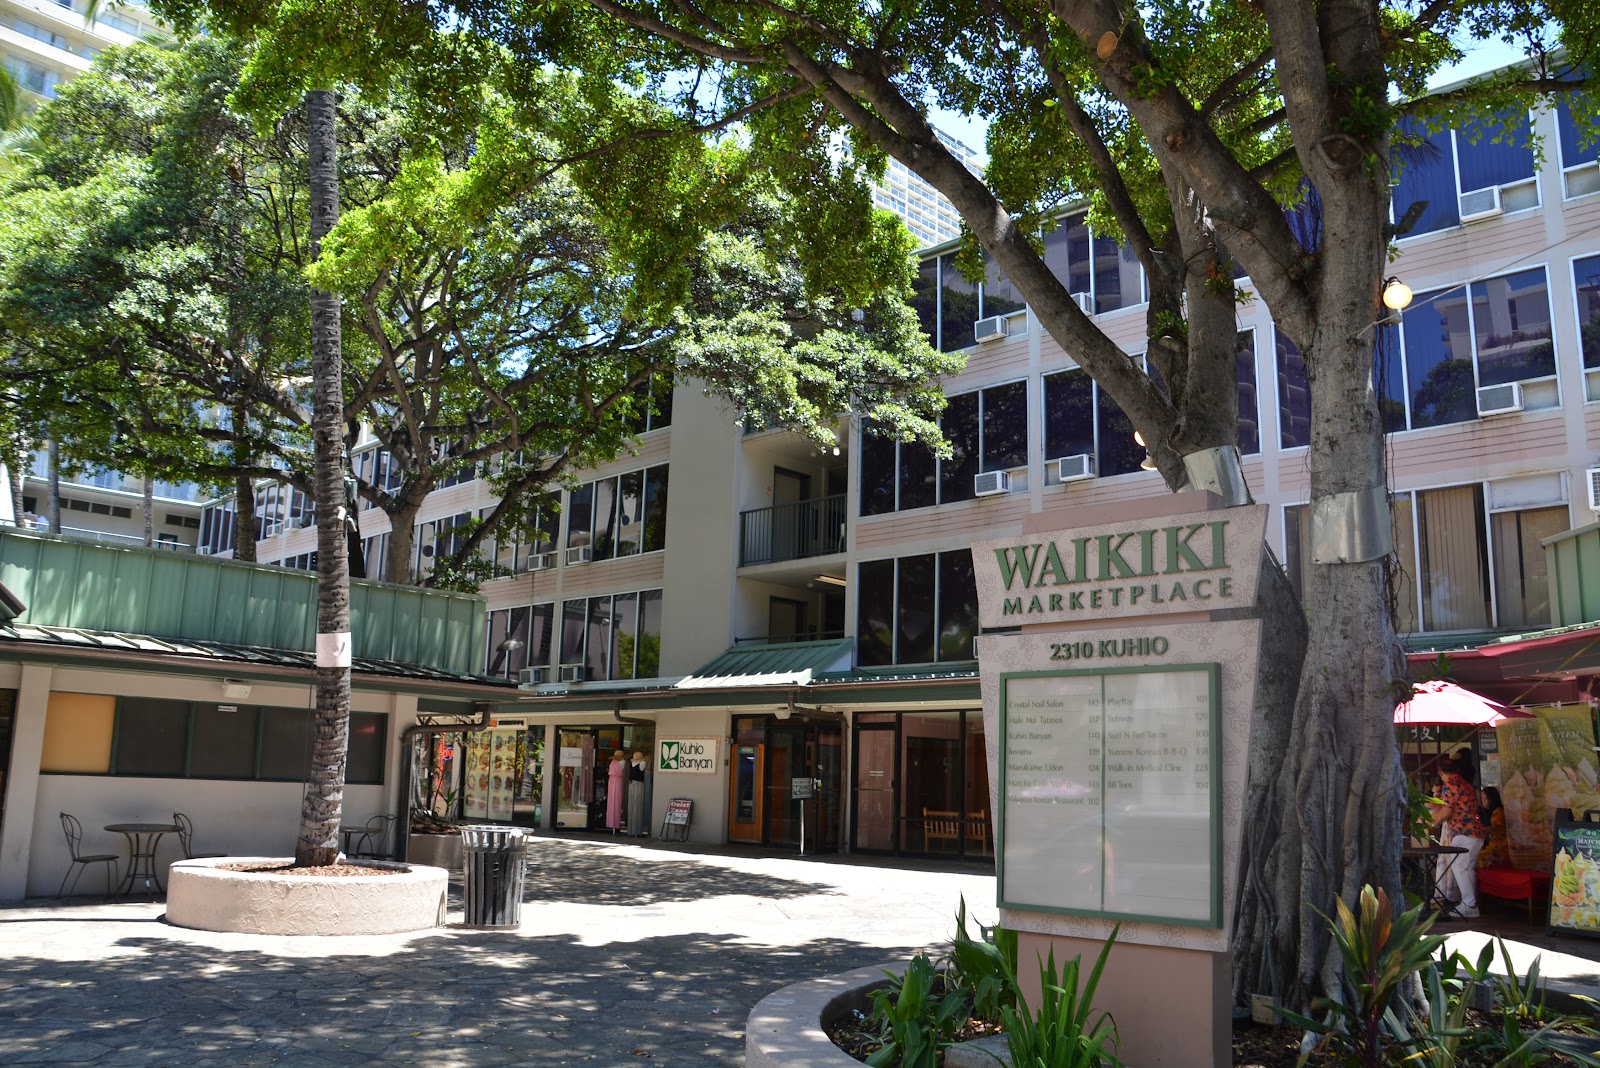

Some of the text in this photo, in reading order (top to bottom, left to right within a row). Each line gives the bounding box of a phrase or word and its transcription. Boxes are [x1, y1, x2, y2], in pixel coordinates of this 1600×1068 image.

[993, 520, 1231, 590] WAIKIKI
[1002, 577, 1232, 616] MARKETPLACE
[1050, 636, 1168, 660] 2310 KUHIO
[1009, 701, 1029, 710] Crystal
[1108, 715, 1134, 723] Subway
[1196, 712, 1208, 720] 120
[1029, 732, 1052, 740] Banyan
[680, 742, 704, 755] Kuhio
[1108, 748, 1133, 757] Yummy
[680, 757, 712, 770] Banyan
